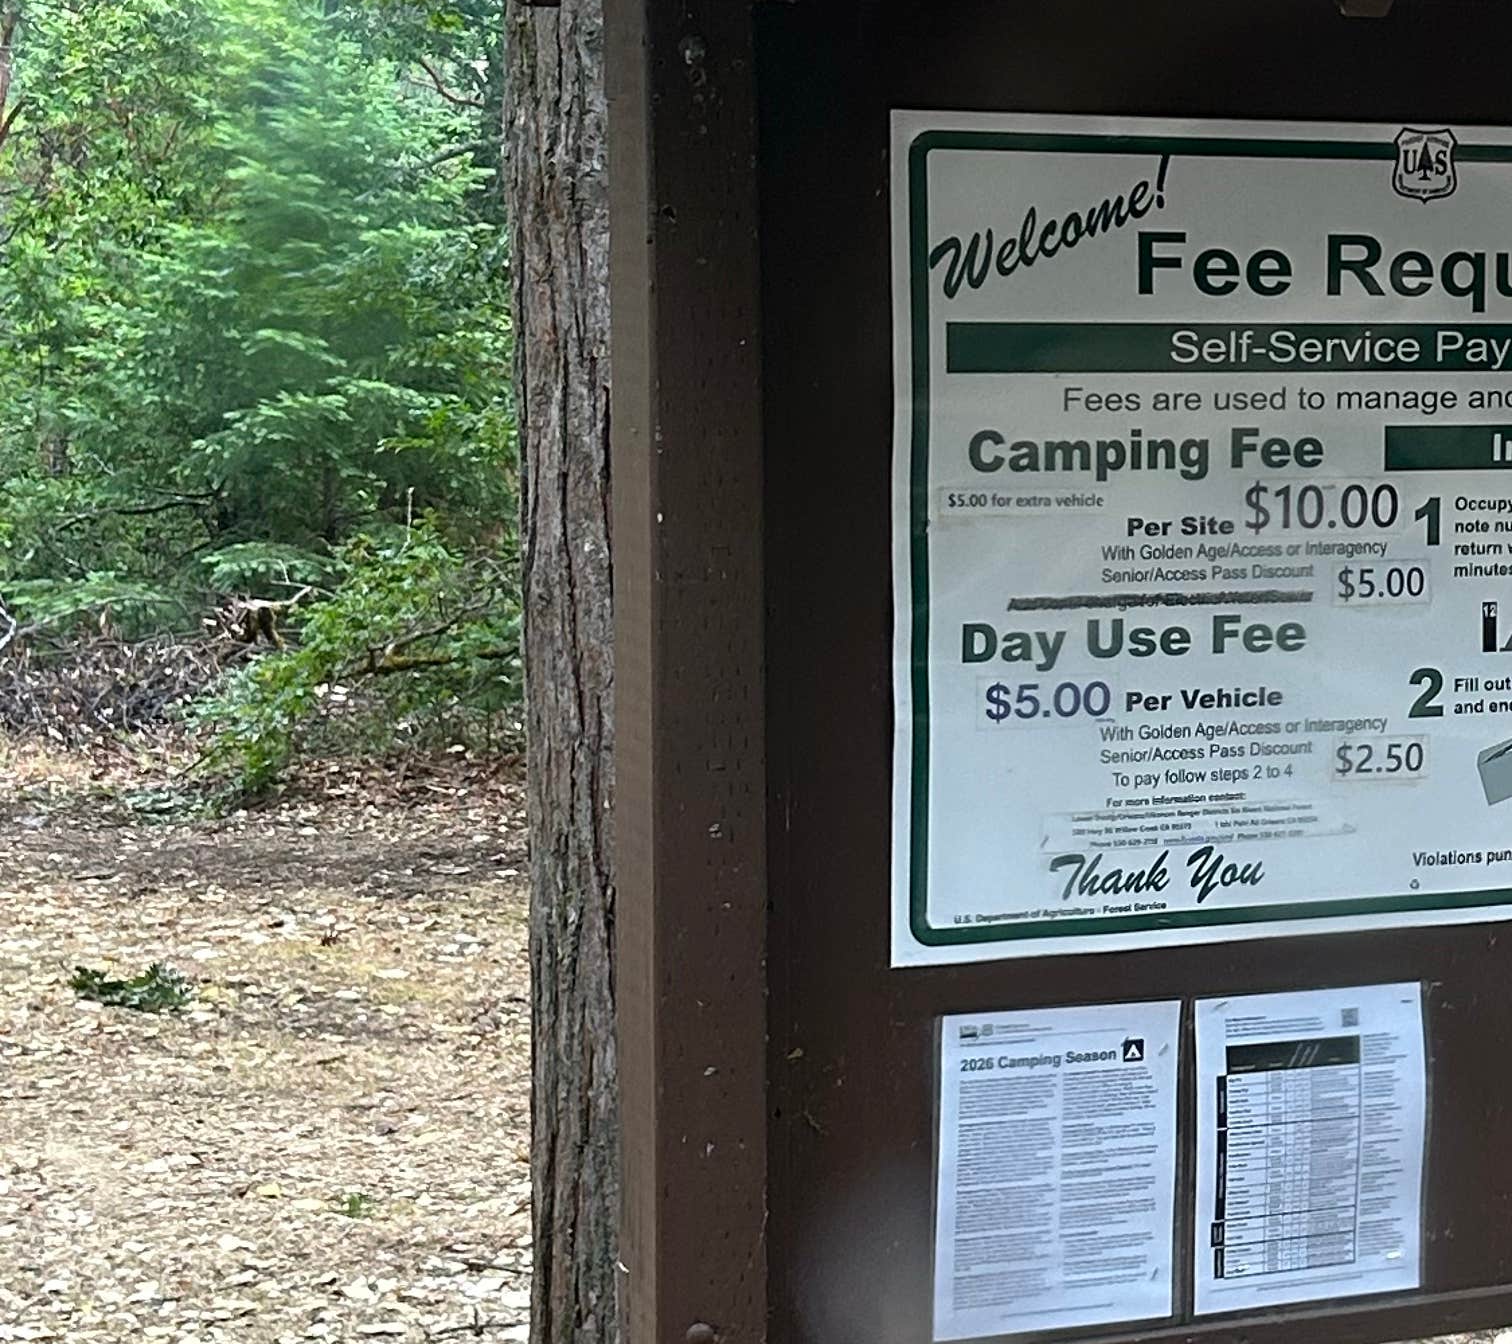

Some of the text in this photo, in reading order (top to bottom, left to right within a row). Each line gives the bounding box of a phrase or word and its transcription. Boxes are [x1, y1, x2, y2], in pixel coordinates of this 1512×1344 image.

[930, 155, 1171, 299] Welcome!
[1137, 231, 1293, 296] Fee
[1171, 330, 1420, 364] Self-Service
[1437, 331, 1510, 369] Pay
[1064, 388, 1140, 412] Fees
[1152, 390, 1202, 411] are
[1215, 387, 1286, 410] used
[1299, 388, 1325, 409] to
[1337, 387, 1458, 415] manage
[968, 427, 1324, 482] Camping Fee
[948, 493, 1104, 509] $5.00 for extra vehicle
[1245, 481, 1398, 535] $10.00
[1128, 517, 1234, 537] Per Site
[1415, 497, 1441, 546] 1
[1455, 518, 1490, 533] note
[1102, 540, 1387, 561] With Golden Age/Access or Interagency
[1455, 542, 1502, 556] return
[1102, 563, 1313, 583] Senior/Access Pass Discount
[1338, 566, 1424, 601] $5.00
[1483, 604, 1496, 618] 12
[962, 614, 1307, 671] Day Use Fee
[1408, 668, 1444, 718] 2
[1454, 678, 1479, 692] Fill
[1484, 678, 1511, 691] out
[986, 681, 1283, 723] $5.00 Per Vehicle
[1454, 699, 1484, 714] and
[1100, 716, 1388, 741] With Golden Age/Access or Interagency
[1100, 741, 1312, 764] Senior/Access Pass Discount
[1336, 742, 1423, 774] $2.50
[1113, 765, 1293, 789] To pay follow steps 2 to 4
[1413, 852, 1482, 867] Violations
[1048, 845, 1264, 903] Thank You
[1103, 902, 1132, 914] Forest
[1135, 900, 1167, 912] Service
[960, 1049, 1116, 1072] 2026 Camping Season
